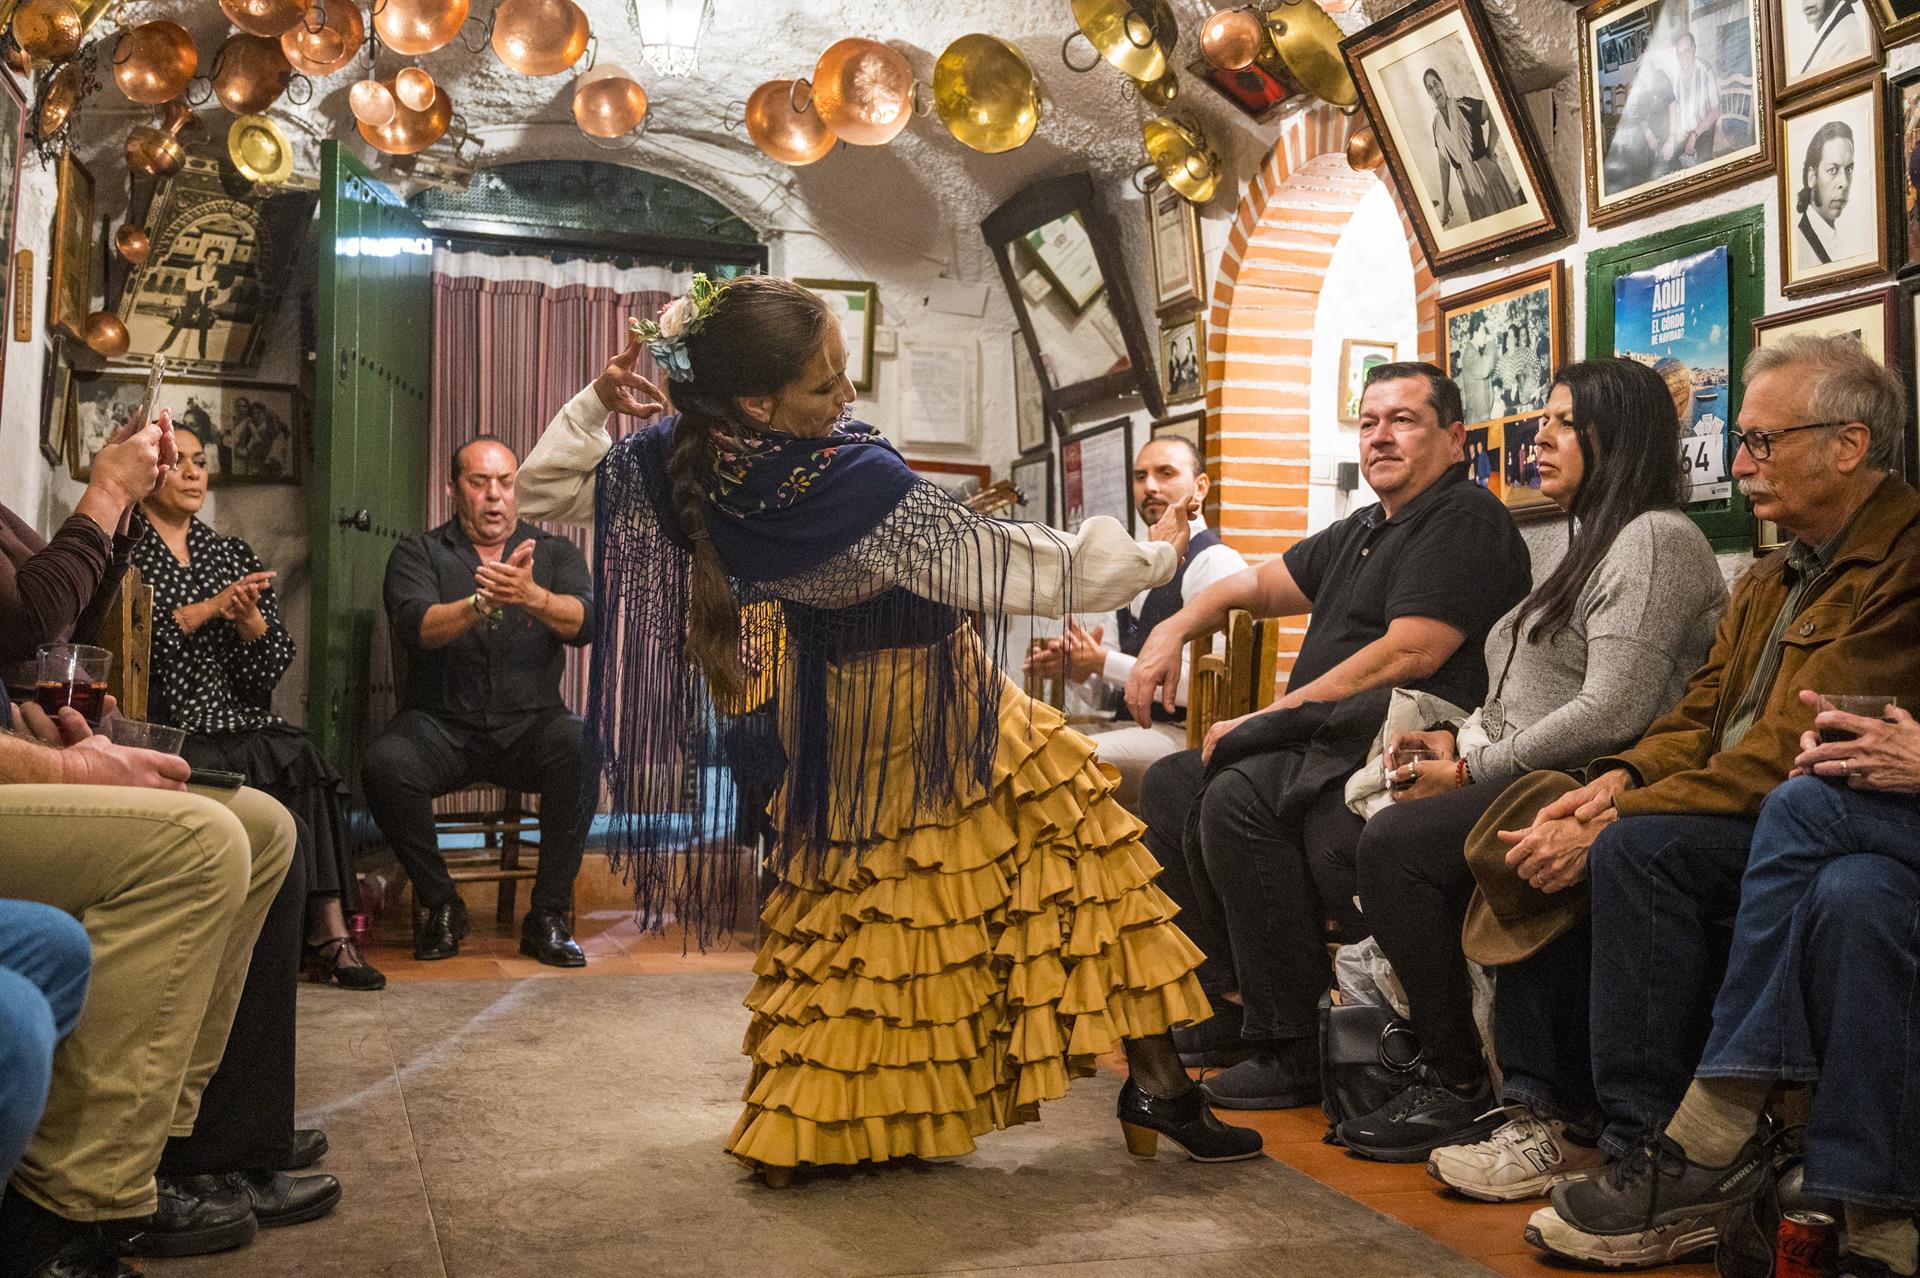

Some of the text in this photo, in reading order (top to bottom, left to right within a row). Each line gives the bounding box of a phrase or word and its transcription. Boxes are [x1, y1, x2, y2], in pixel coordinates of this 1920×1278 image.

[1652, 271, 1686, 313] AQUÍ
[1651, 333, 1659, 346] DE
[1652, 312, 1685, 335] EL GORDO
[1522, 1139, 1561, 1173] N
[1719, 1160, 1760, 1193] MERRELL
